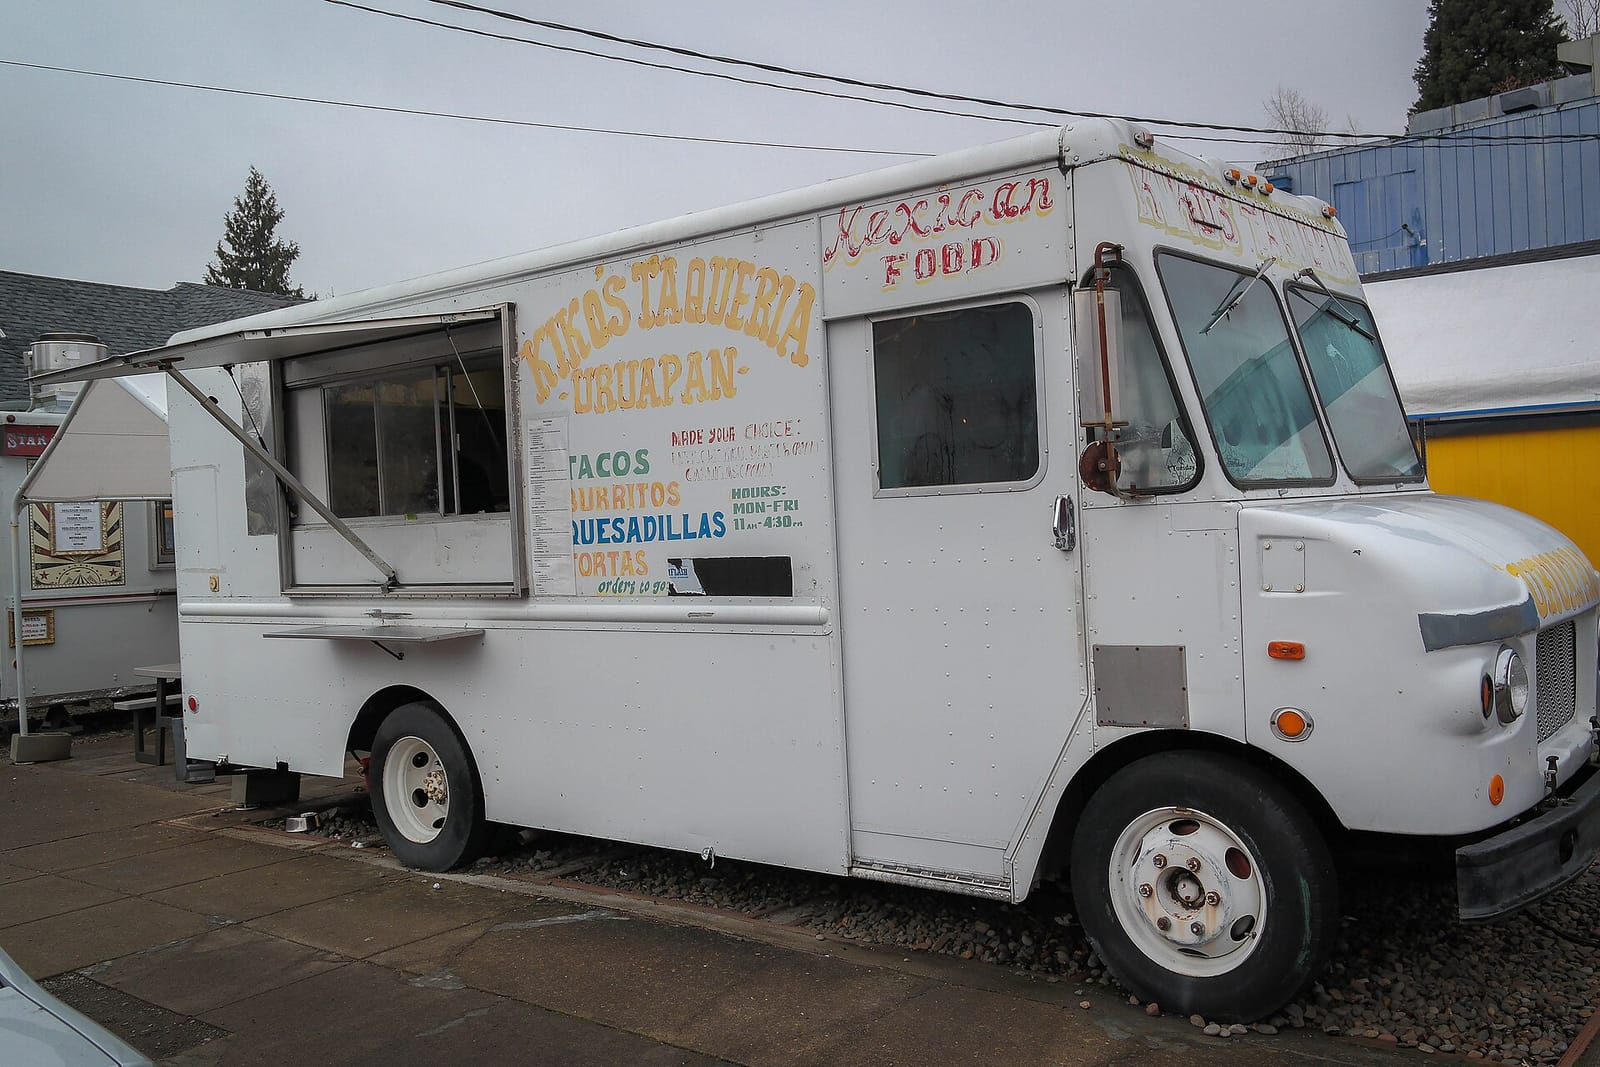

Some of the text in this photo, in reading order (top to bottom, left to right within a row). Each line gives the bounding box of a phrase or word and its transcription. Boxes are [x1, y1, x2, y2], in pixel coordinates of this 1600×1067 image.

[880, 236, 1003, 288] FOOD
[631, 255, 816, 368] TAQUERIA
[7, 432, 47, 448] STAR
[731, 485, 786, 499] HOURS:
[733, 499, 799, 514] MON-FRI
[574, 550, 649, 577] ORTAS
[598, 577, 636, 595] orders
[639, 581, 650, 593] to
